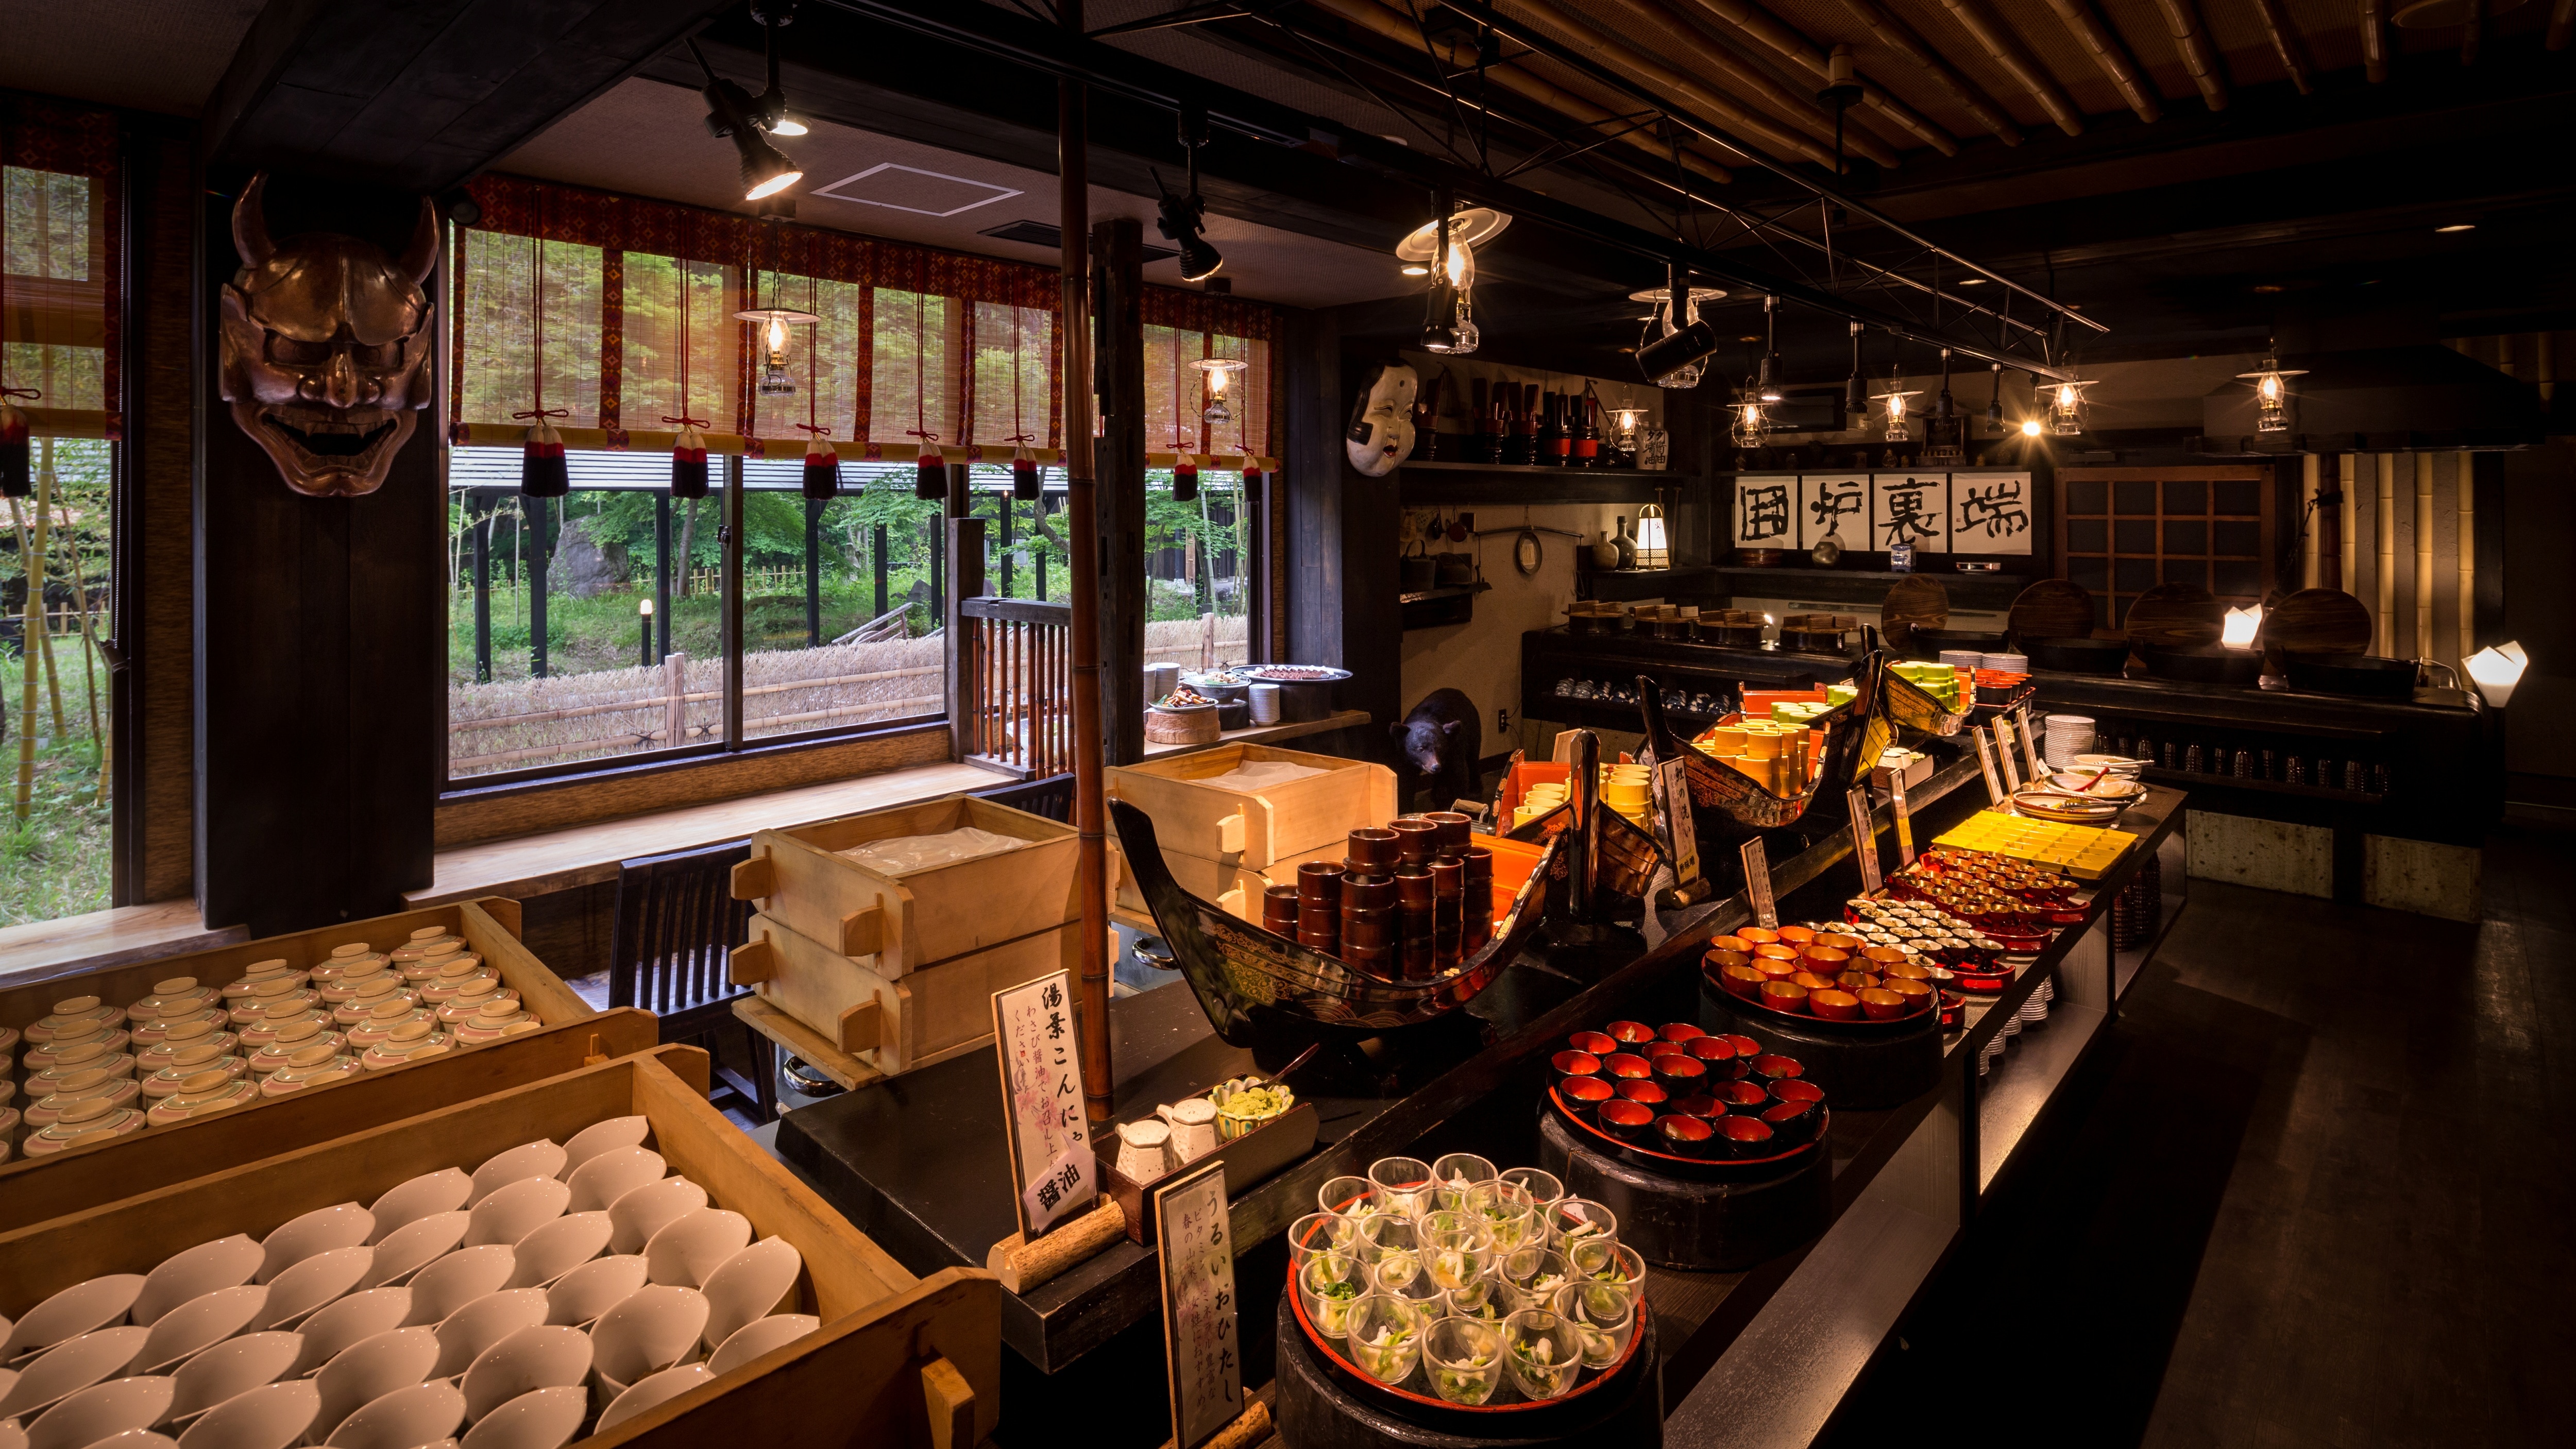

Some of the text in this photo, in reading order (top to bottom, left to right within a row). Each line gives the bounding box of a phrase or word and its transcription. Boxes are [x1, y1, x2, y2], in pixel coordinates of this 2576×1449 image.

[1675, 765, 1691, 838] 鯉の洗い
[1014, 1010, 1030, 1067] ください
[1037, 1163, 1081, 1212] 醤油
[1207, 1190, 1234, 1402] うるいおひたし
